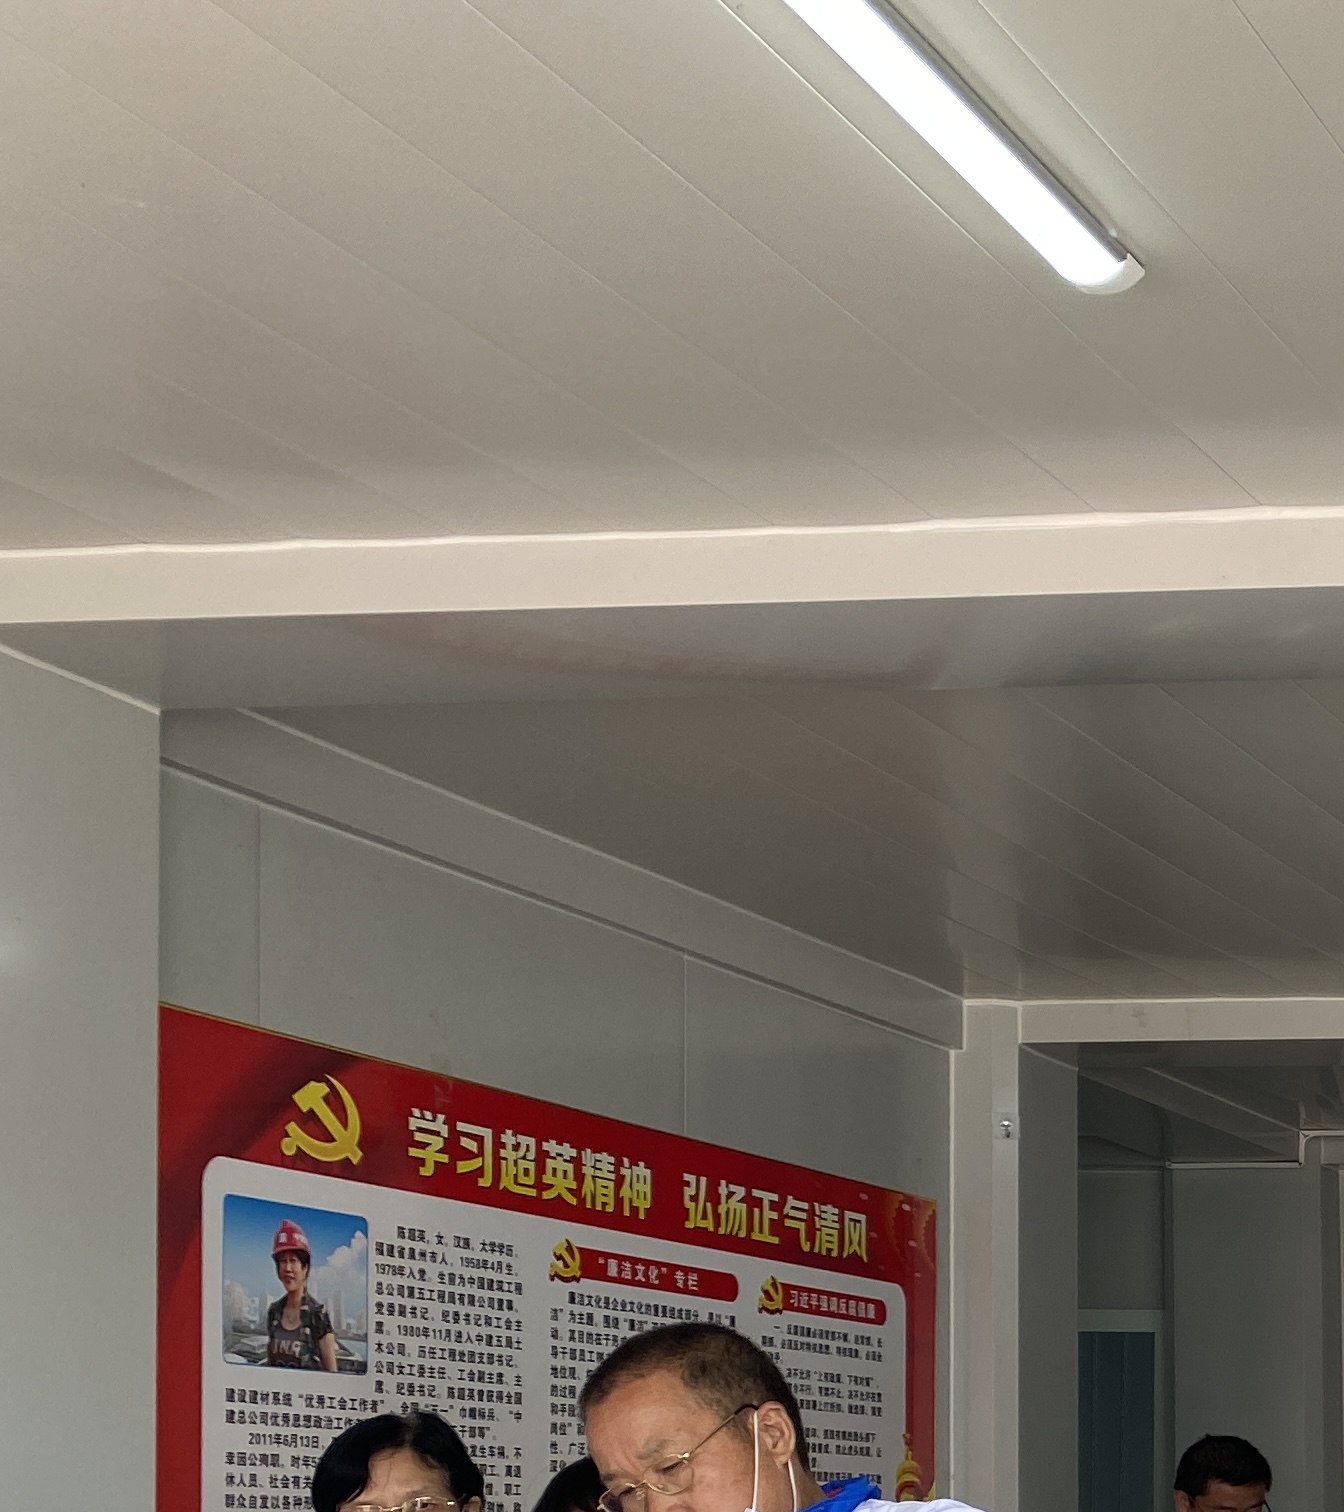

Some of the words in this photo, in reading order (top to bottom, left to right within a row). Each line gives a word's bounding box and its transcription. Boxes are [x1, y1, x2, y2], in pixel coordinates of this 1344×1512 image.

[408, 1108, 652, 1219] 学习超英精神
[683, 1173, 868, 1263] 弘扬正气清风
